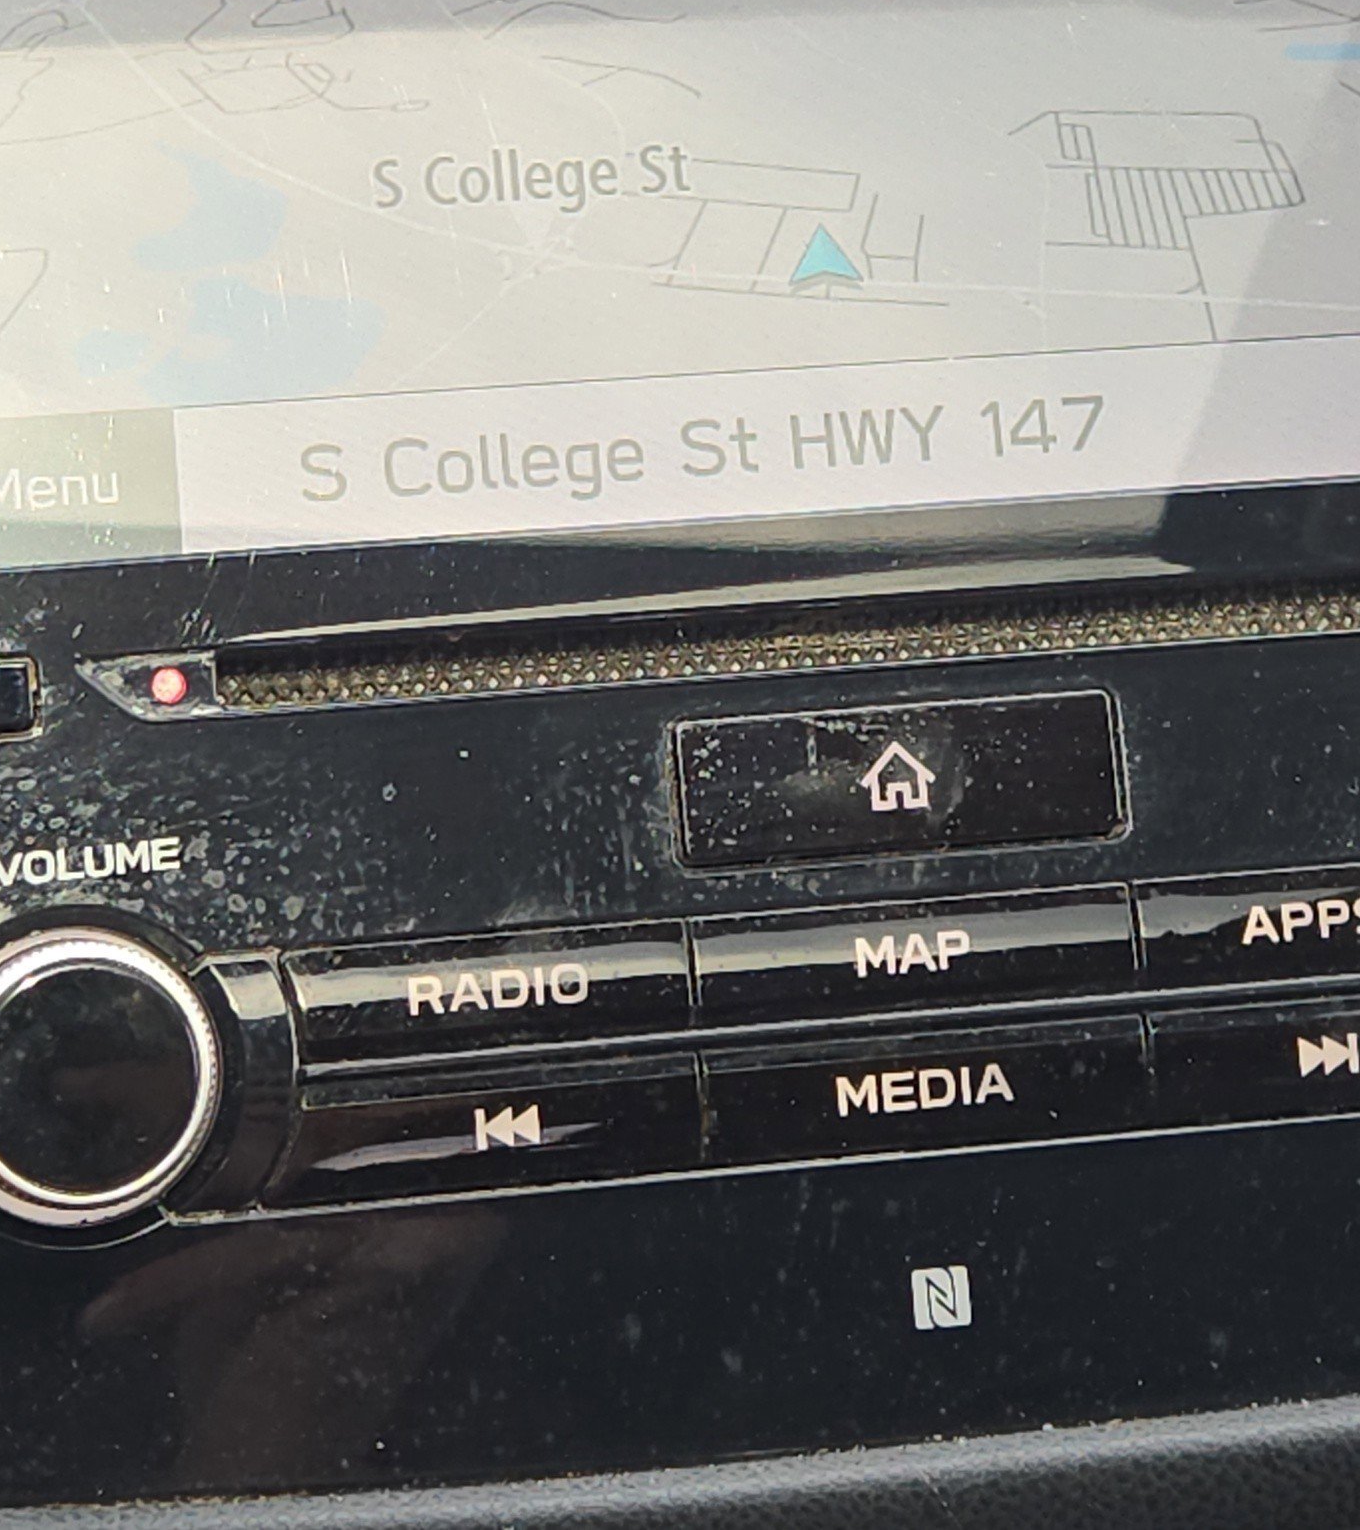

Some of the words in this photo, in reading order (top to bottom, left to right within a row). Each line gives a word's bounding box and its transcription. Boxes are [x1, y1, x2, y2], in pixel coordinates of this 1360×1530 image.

[373, 158, 403, 209] S
[424, 147, 618, 213] College
[640, 144, 691, 194] St
[300, 443, 347, 502] S
[384, 432, 644, 500] College
[681, 417, 759, 477] St
[789, 405, 945, 470] HWY
[980, 395, 1104, 458] 147
[853, 929, 972, 979] MAP
[407, 962, 589, 1017] RADIO
[834, 1062, 1015, 1117] MEDIA
